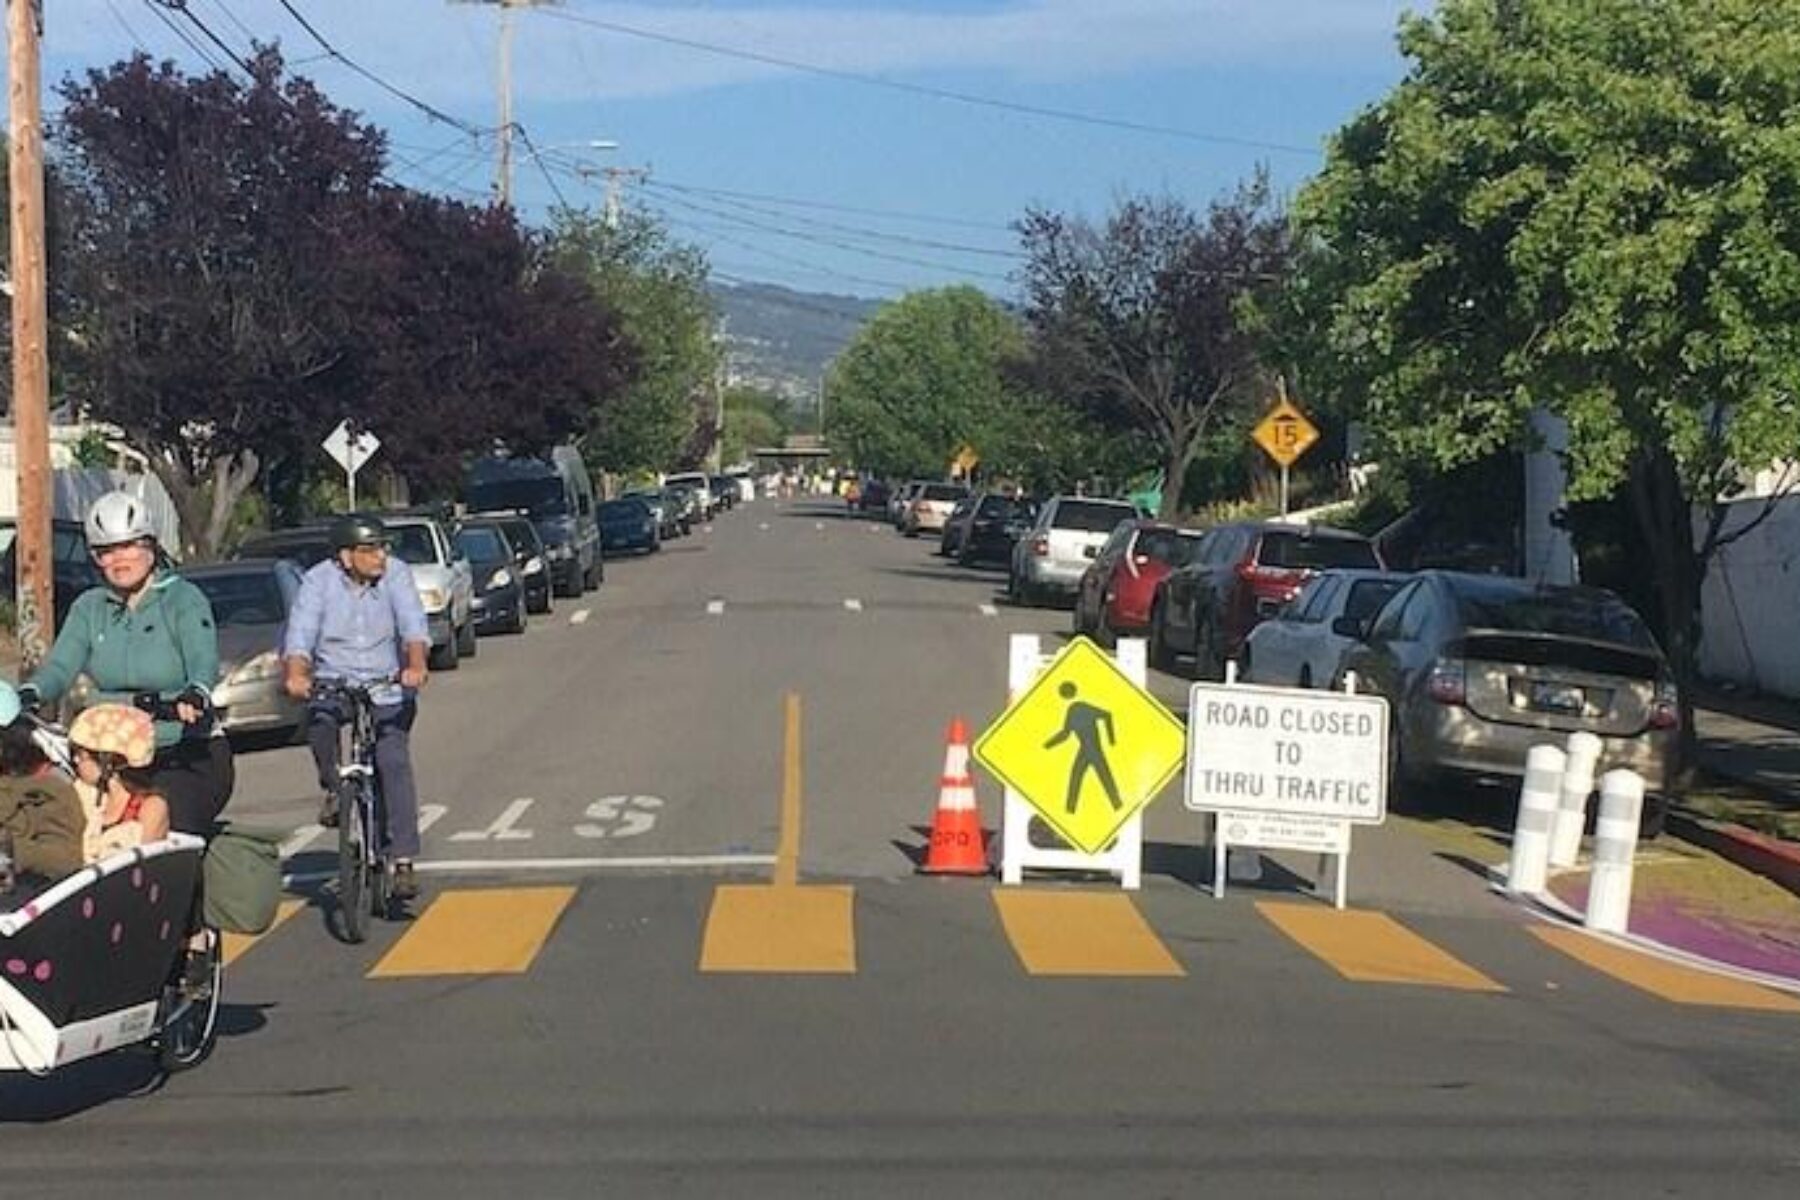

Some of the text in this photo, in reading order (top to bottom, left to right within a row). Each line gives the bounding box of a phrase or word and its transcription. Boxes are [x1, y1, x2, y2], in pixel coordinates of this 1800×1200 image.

[1274, 423, 1297, 447] 15
[1206, 701, 1373, 737] ROAD CLOSED
[1274, 740, 1302, 766] TO
[1203, 769, 1371, 806] THRU TRAFFIC
